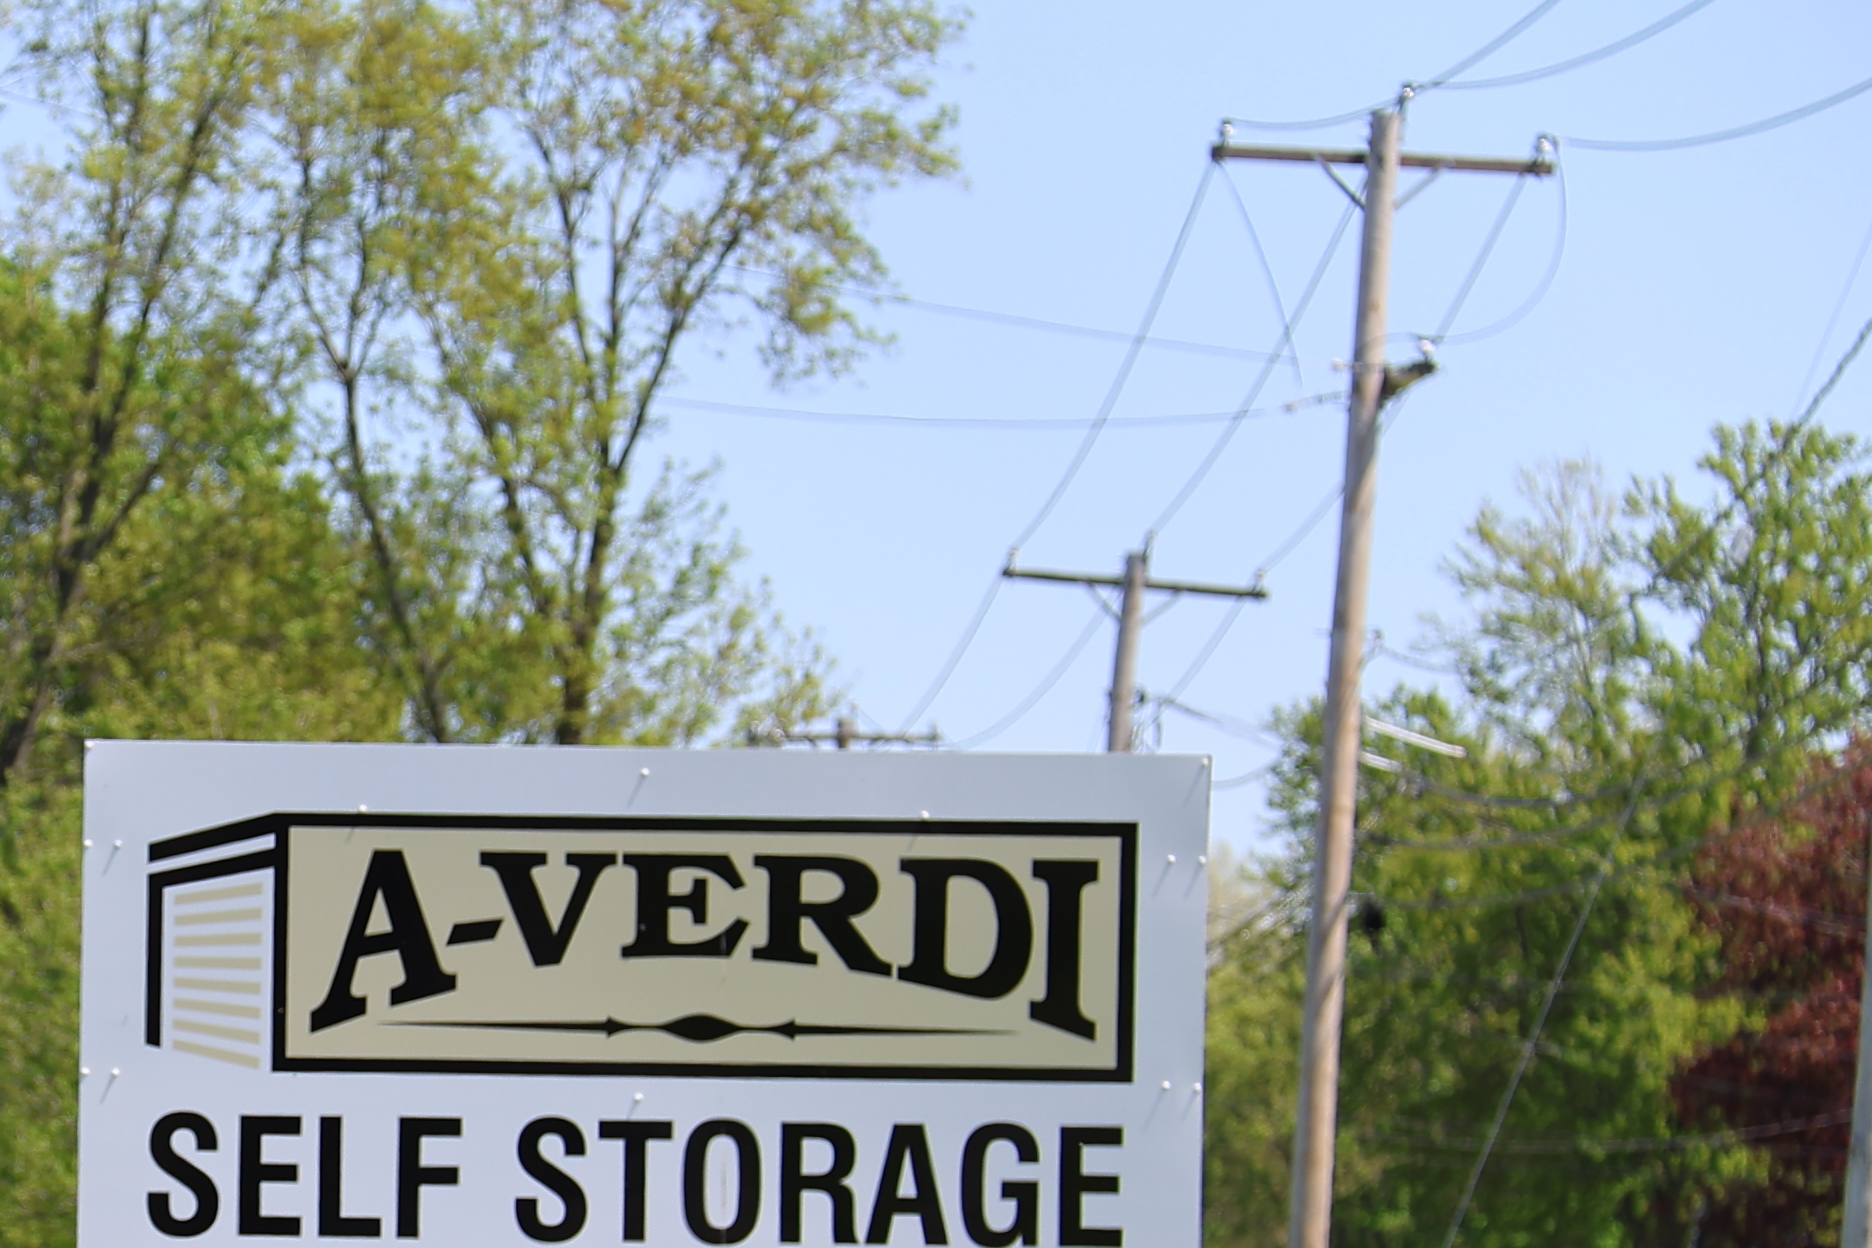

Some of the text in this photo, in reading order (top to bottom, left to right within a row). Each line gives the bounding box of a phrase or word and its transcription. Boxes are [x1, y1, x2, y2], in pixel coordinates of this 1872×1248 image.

[310, 849, 1100, 1043] A-VERDI
[147, 1111, 1123, 1248] SELF STORAGE
